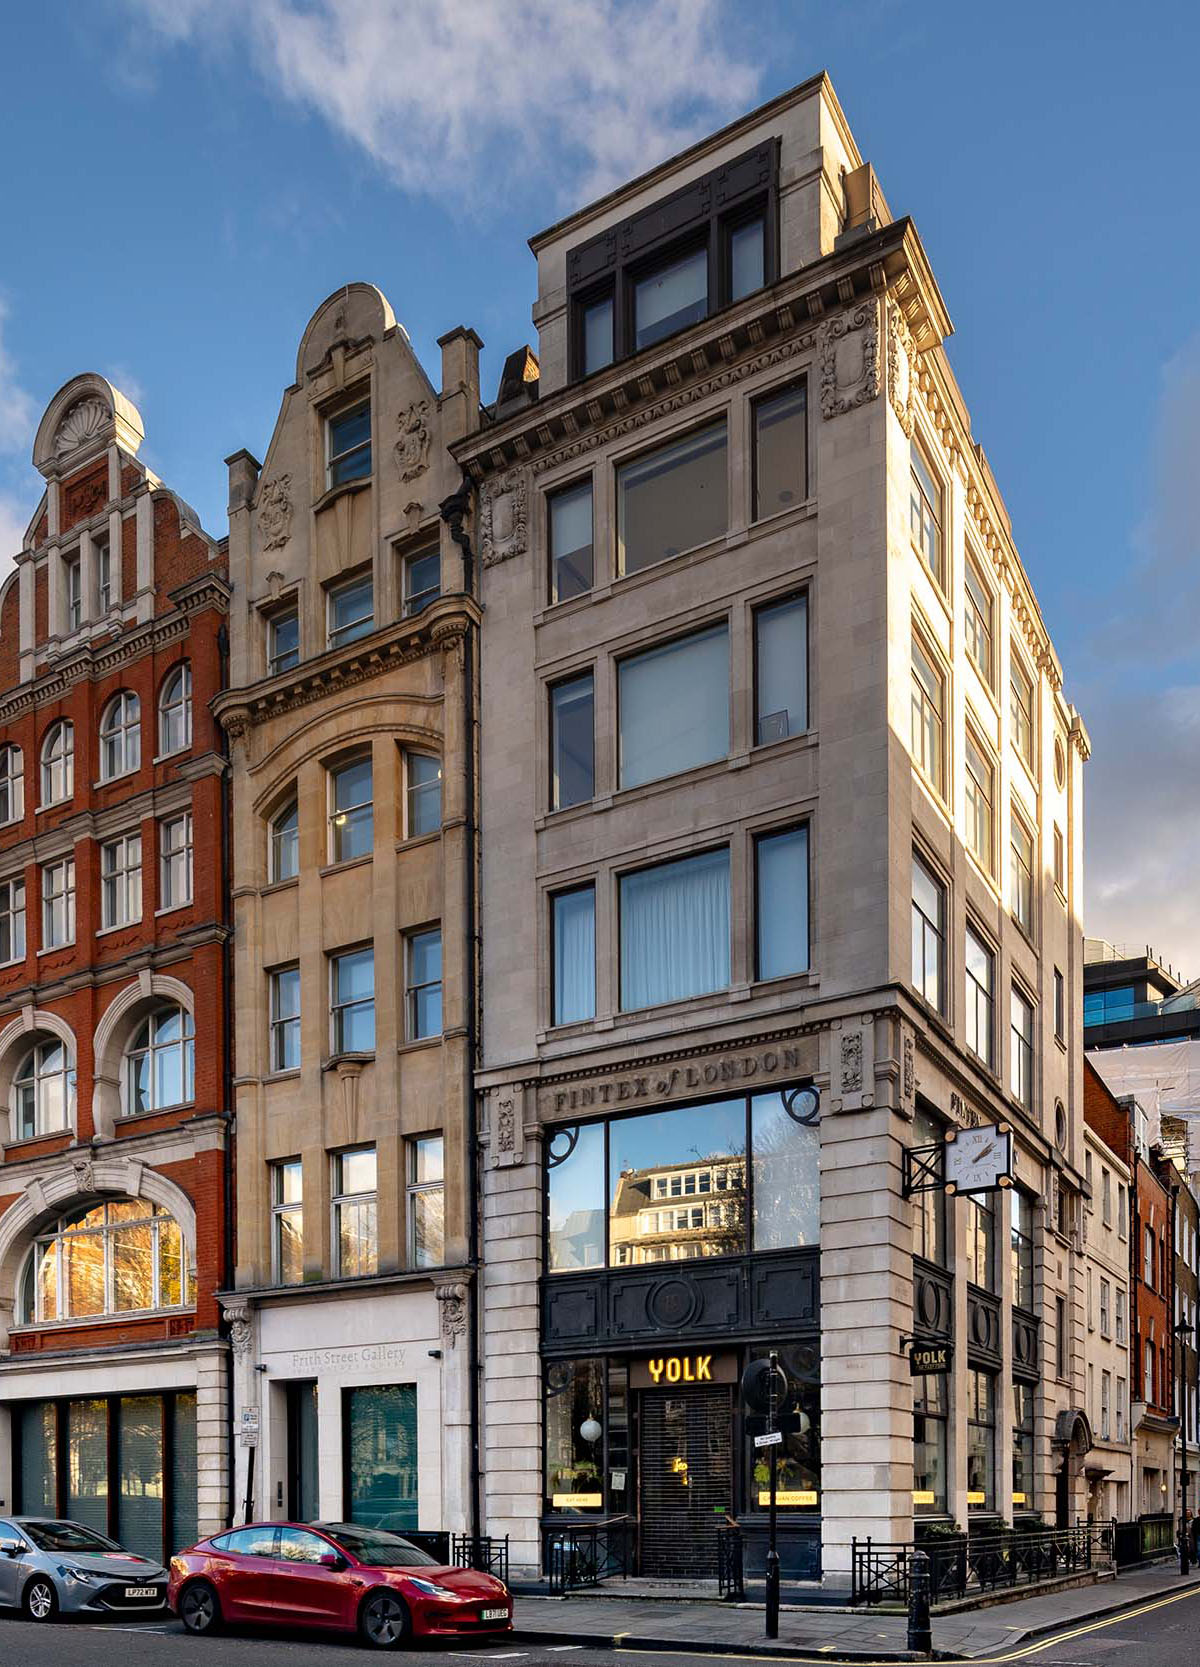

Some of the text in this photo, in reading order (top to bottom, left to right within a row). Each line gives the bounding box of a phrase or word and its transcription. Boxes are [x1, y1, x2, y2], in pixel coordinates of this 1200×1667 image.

[553, 1047, 800, 1112] FINTEX of LONDON
[292, 1346, 406, 1367] Frith Street Gallery
[914, 1350, 946, 1365] YOLK
[648, 1355, 712, 1383] YOLK
